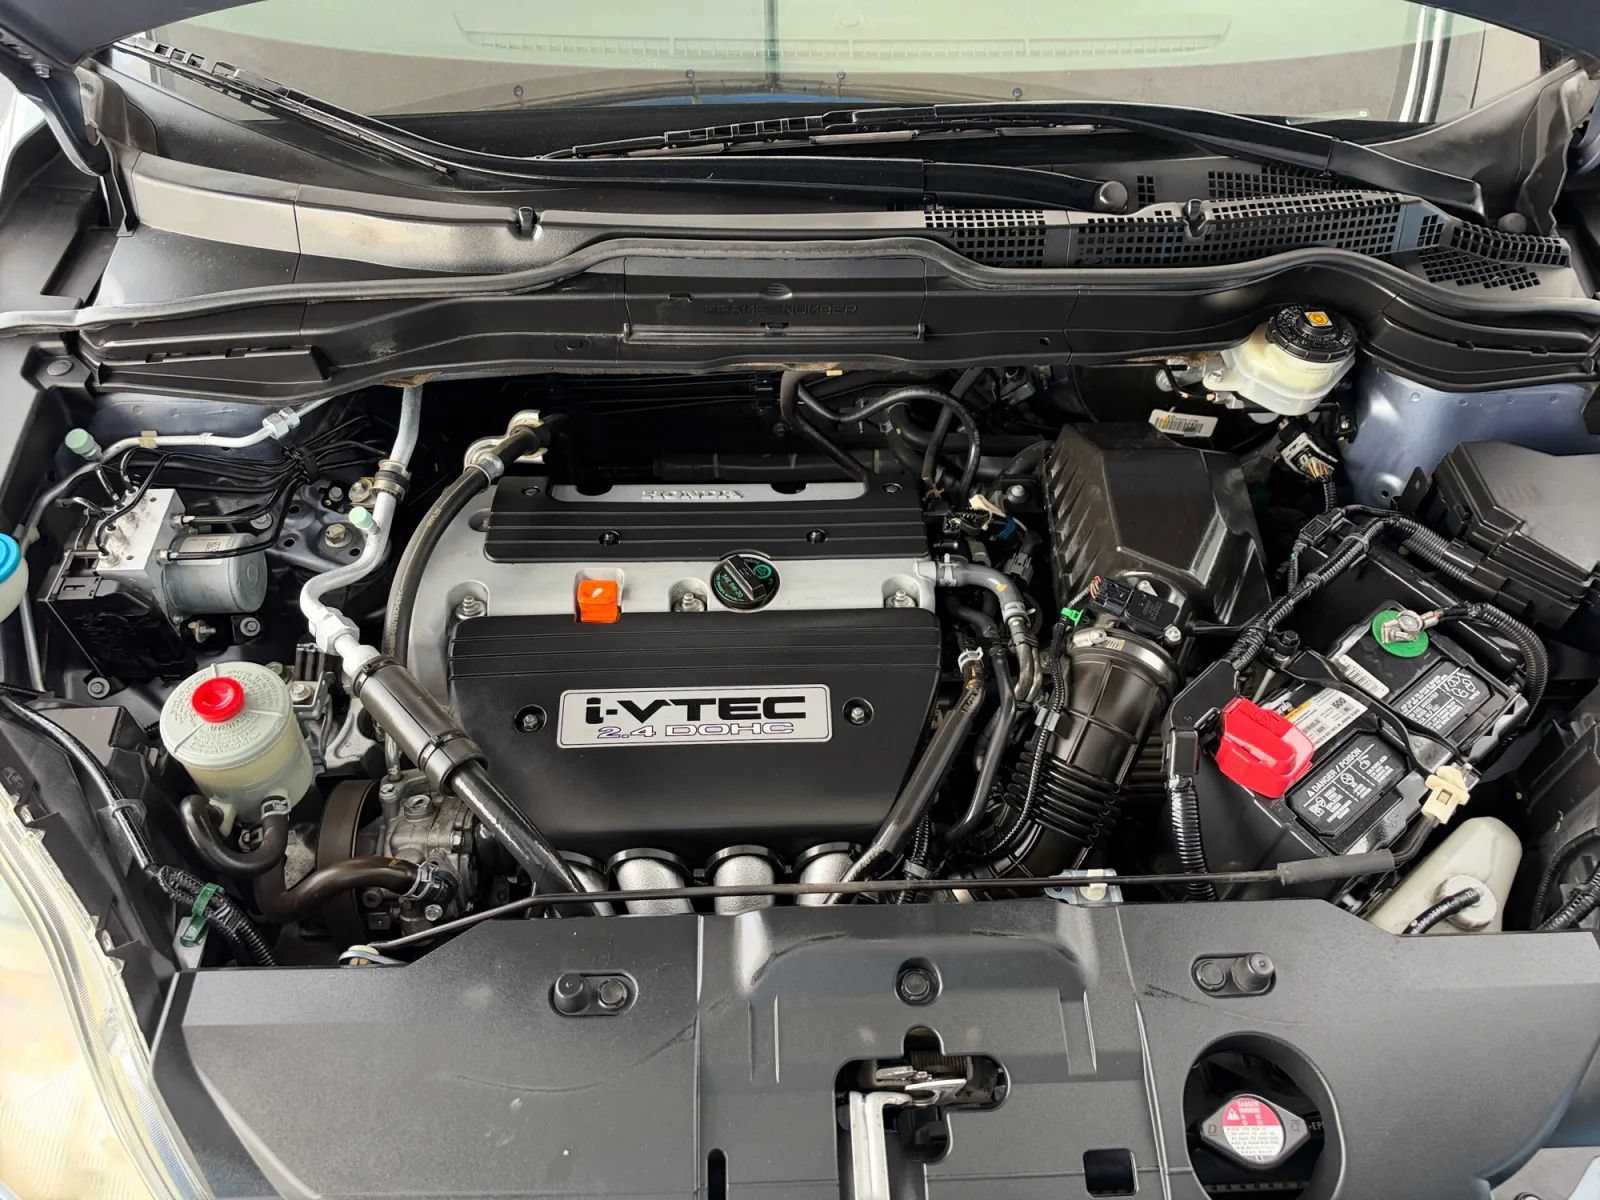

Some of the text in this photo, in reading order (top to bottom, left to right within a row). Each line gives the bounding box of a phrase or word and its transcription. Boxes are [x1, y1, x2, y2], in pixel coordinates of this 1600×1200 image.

[704, 303, 857, 315] FRAME NUMBER
[641, 488, 744, 501] HONDA
[585, 695, 807, 724] i-VTEC
[1331, 697, 1346, 709] 500
[597, 722, 794, 739] 2.4 DOHC
[1311, 769, 1338, 793] DANGER
[1338, 747, 1363, 769] POISON
